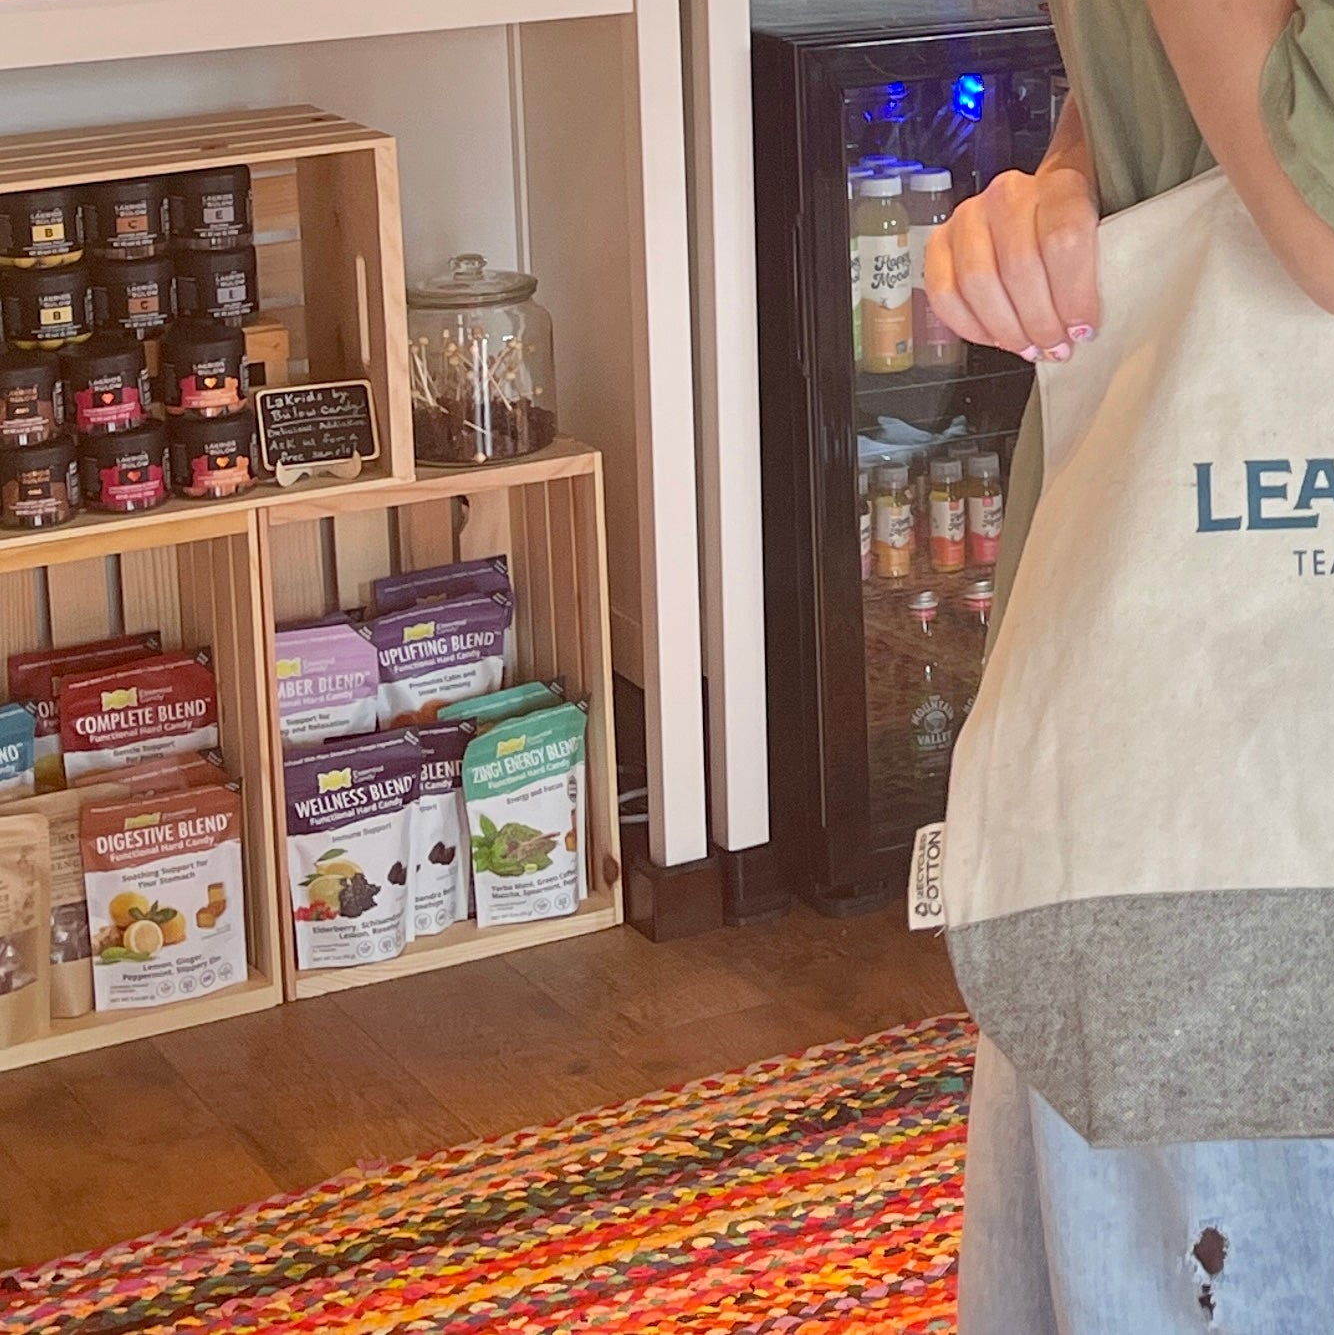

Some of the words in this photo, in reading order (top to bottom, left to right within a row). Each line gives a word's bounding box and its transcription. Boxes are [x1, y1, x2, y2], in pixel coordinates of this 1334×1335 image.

[45, 228, 53, 237] B
[128, 220, 138, 229] C
[331, 389, 349, 404] by
[379, 637, 448, 667] UPLIFTING
[450, 631, 495, 652] BLEND
[318, 672, 365, 694] BLEND
[76, 706, 153, 735] COMPLETE
[157, 698, 207, 722] BLEND
[89, 728, 139, 744] Functional
[139, 724, 163, 736] Hard
[164, 720, 193, 732] Candy
[503, 746, 546, 774] ENERGY
[294, 786, 367, 819] WELLNESS
[368, 775, 413, 801] BLEND
[356, 804, 378, 816] Hard
[95, 823, 175, 855] DIGESTIVE
[178, 812, 229, 839] BLEND
[109, 844, 160, 863] Functional
[160, 839, 184, 852] Hard
[185, 835, 215, 848] Candy
[121, 869, 160, 883] Soothing
[161, 861, 195, 875] Support
[159, 871, 196, 885] Stomach
[926, 830, 942, 916] COTTON
